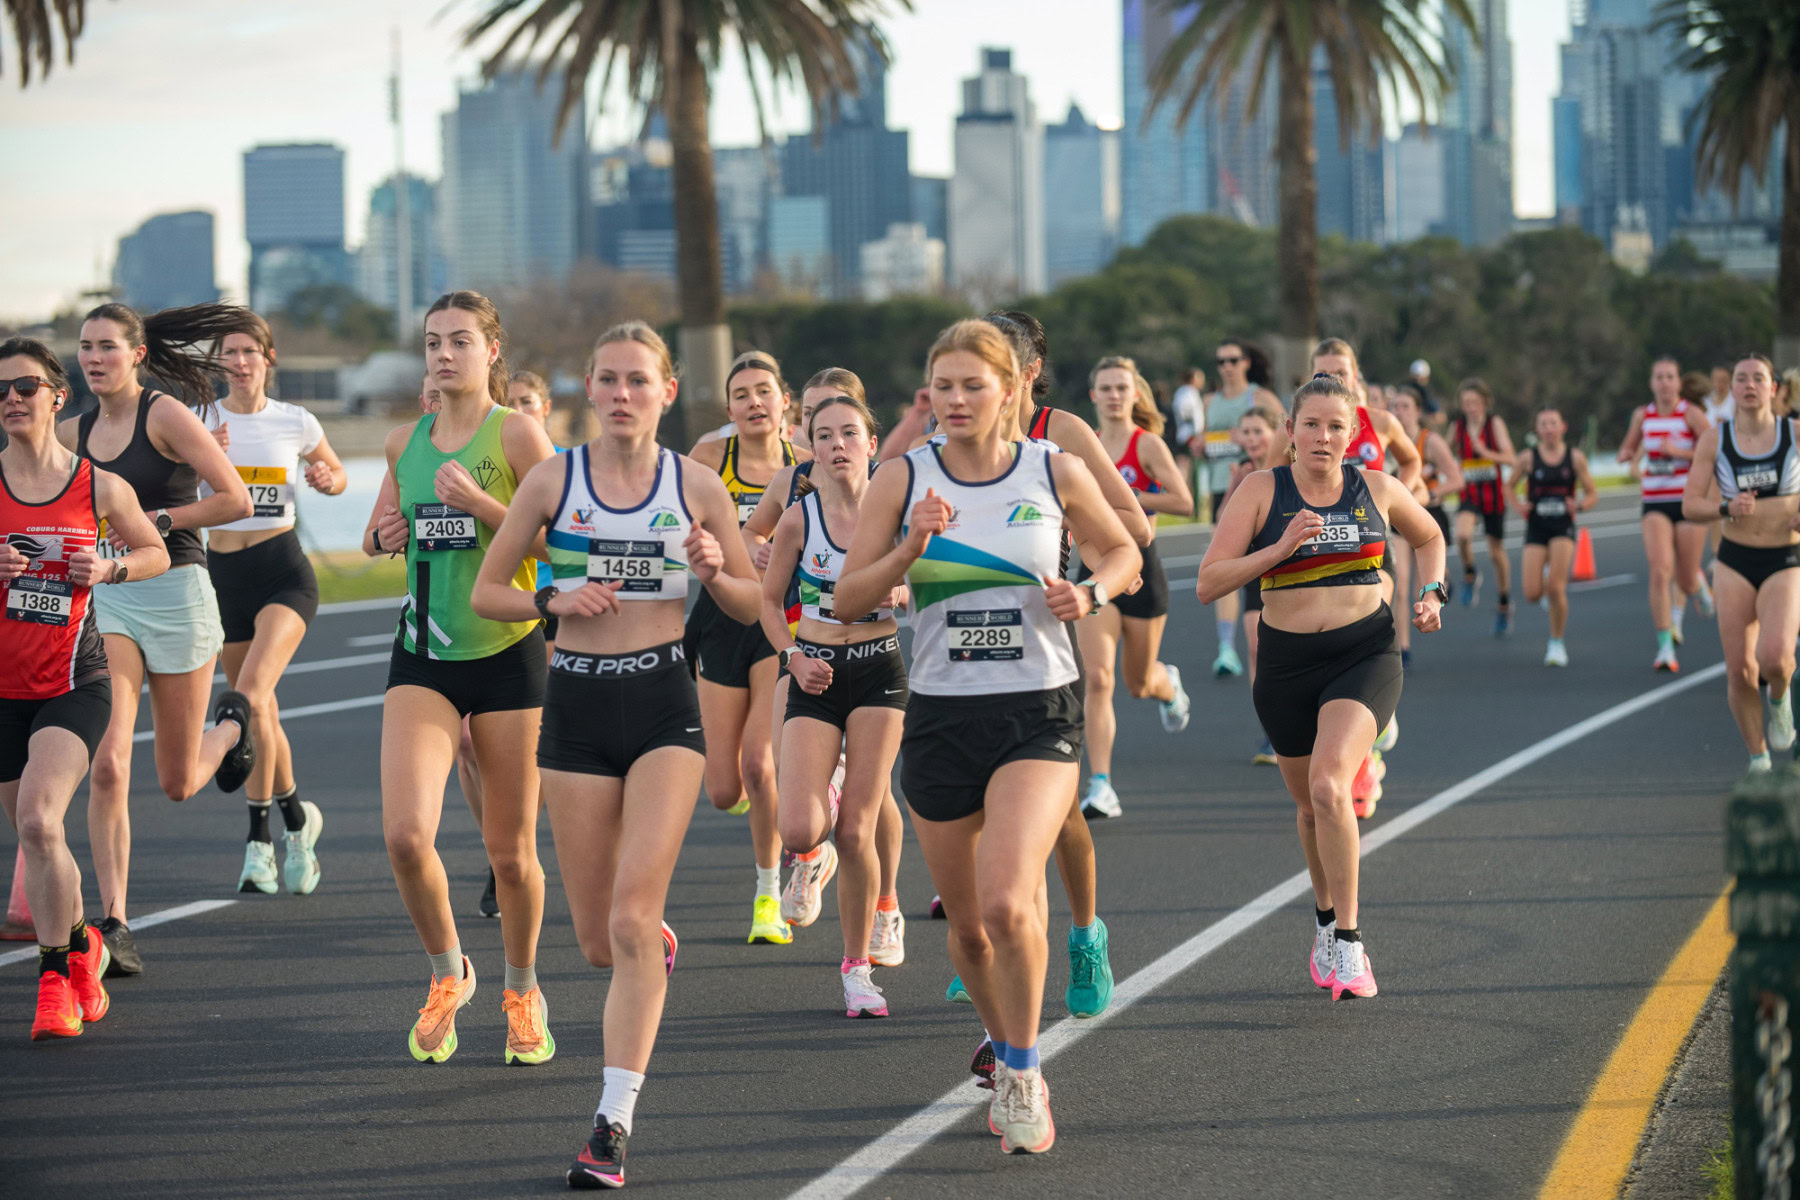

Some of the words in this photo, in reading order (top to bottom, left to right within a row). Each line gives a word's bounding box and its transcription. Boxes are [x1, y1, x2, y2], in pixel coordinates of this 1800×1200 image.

[57, 526, 88, 535] HARRIERS
[425, 520, 466, 537] 2403
[602, 559, 651, 577] 1458
[20, 593, 61, 613] 1388
[960, 629, 1011, 647] 2289
[846, 637, 897, 661] NIKE
[595, 652, 660, 675] PRO
